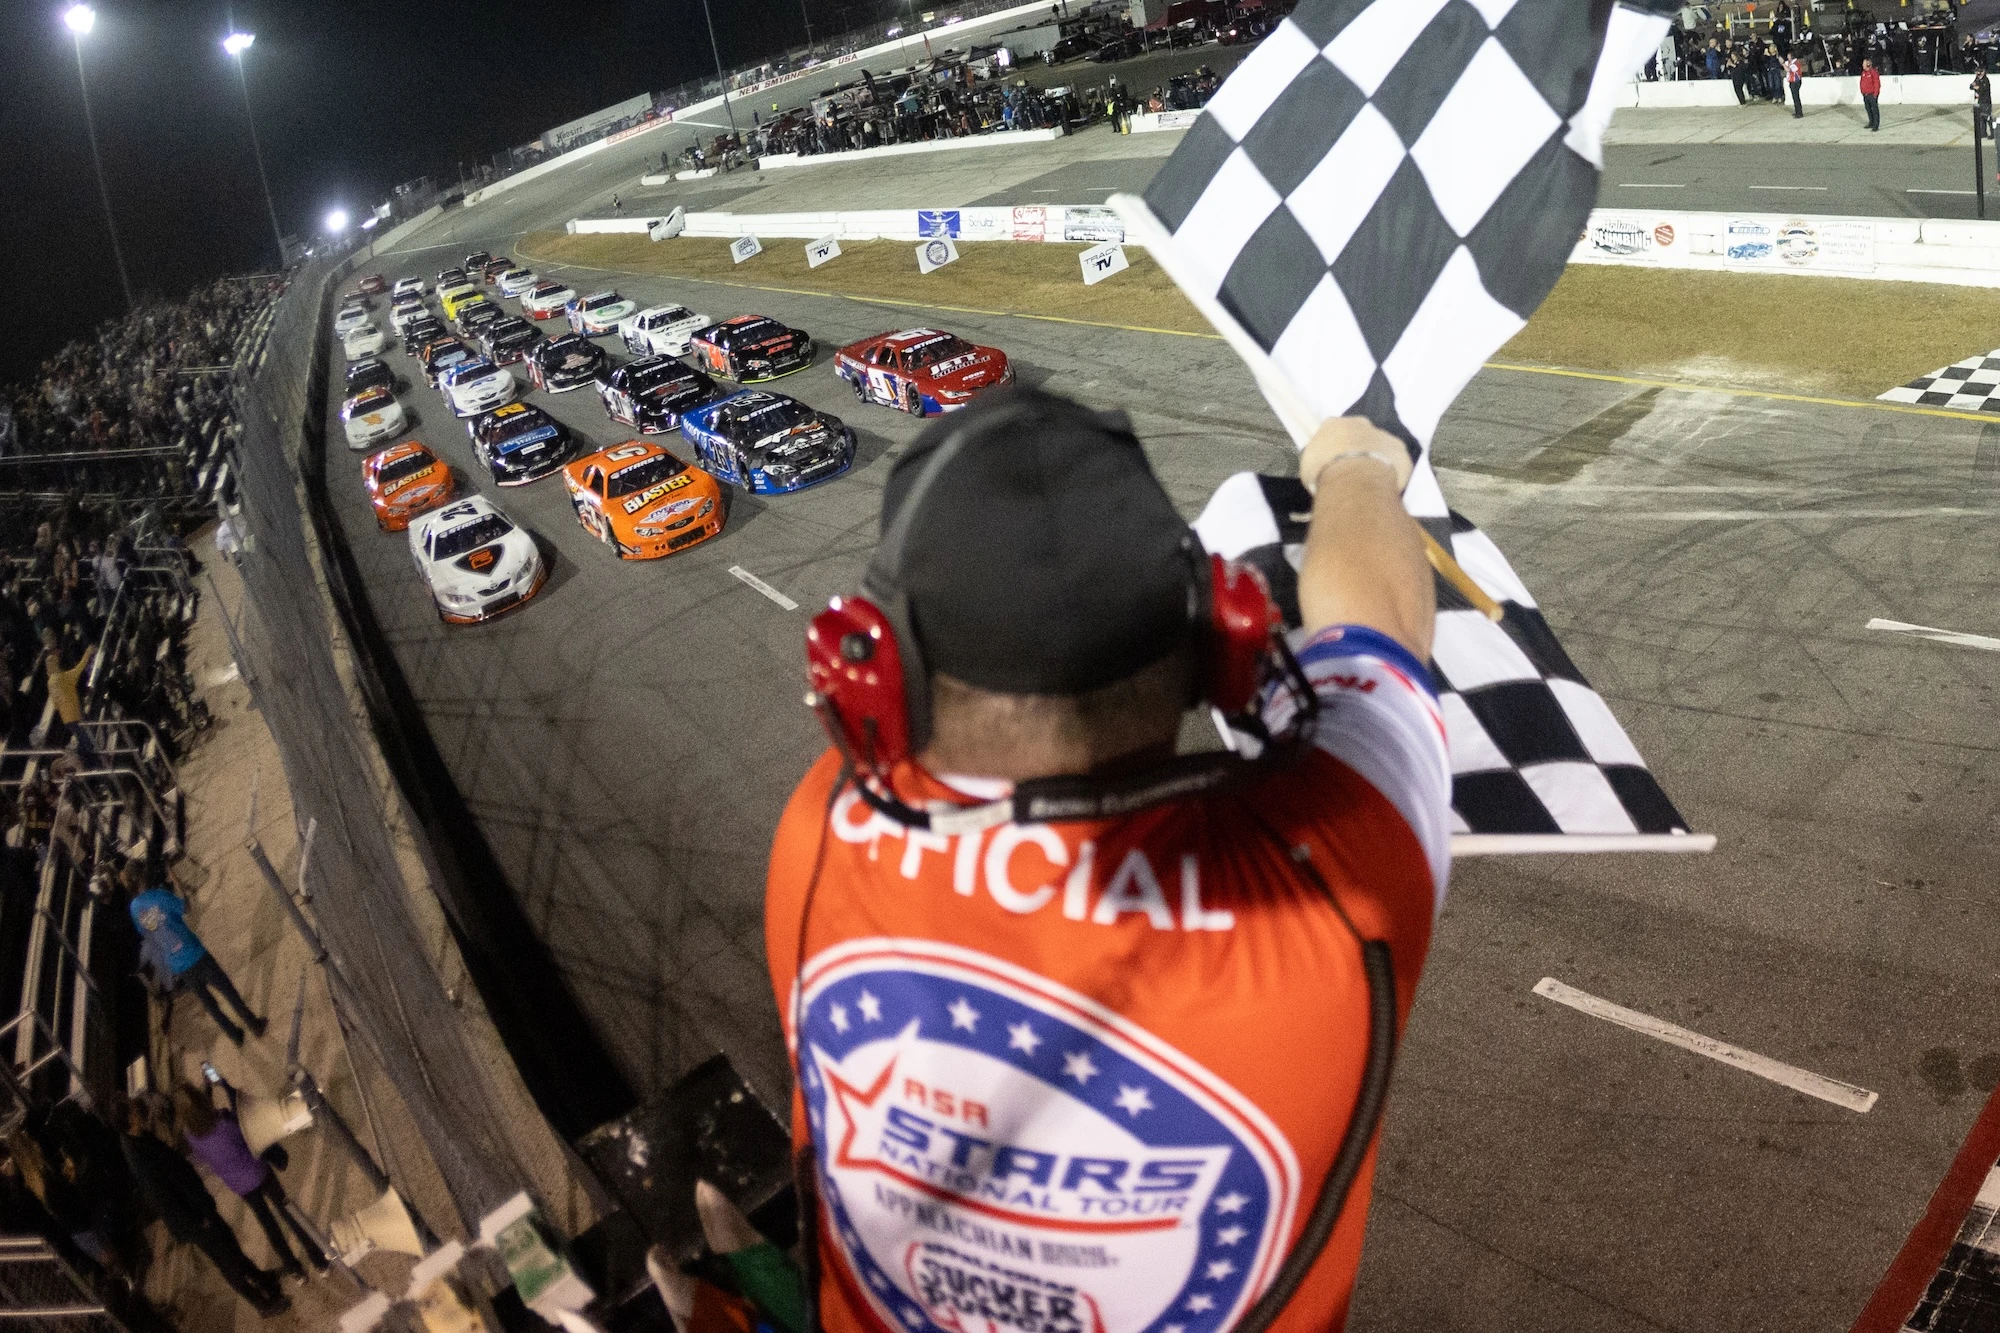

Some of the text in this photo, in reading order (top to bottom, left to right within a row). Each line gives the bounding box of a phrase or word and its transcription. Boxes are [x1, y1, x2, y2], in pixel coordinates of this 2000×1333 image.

[739, 85, 760, 97] NEW
[838, 53, 858, 65] USA
[1591, 229, 1652, 251] PLUMBING
[817, 247, 829, 257] TV
[1084, 245, 1119, 265] TRACK
[1096, 256, 1112, 271] TV
[930, 352, 976, 375] JETT
[750, 401, 783, 418] STARS
[620, 457, 655, 475] STARS
[384, 467, 434, 497] BLASTER
[622, 475, 692, 514] BLASTER
[832, 789, 1235, 931] OFICIAL
[884, 1105, 1209, 1193] STARS
[879, 1139, 1192, 1217] NATIONAL TOUR
